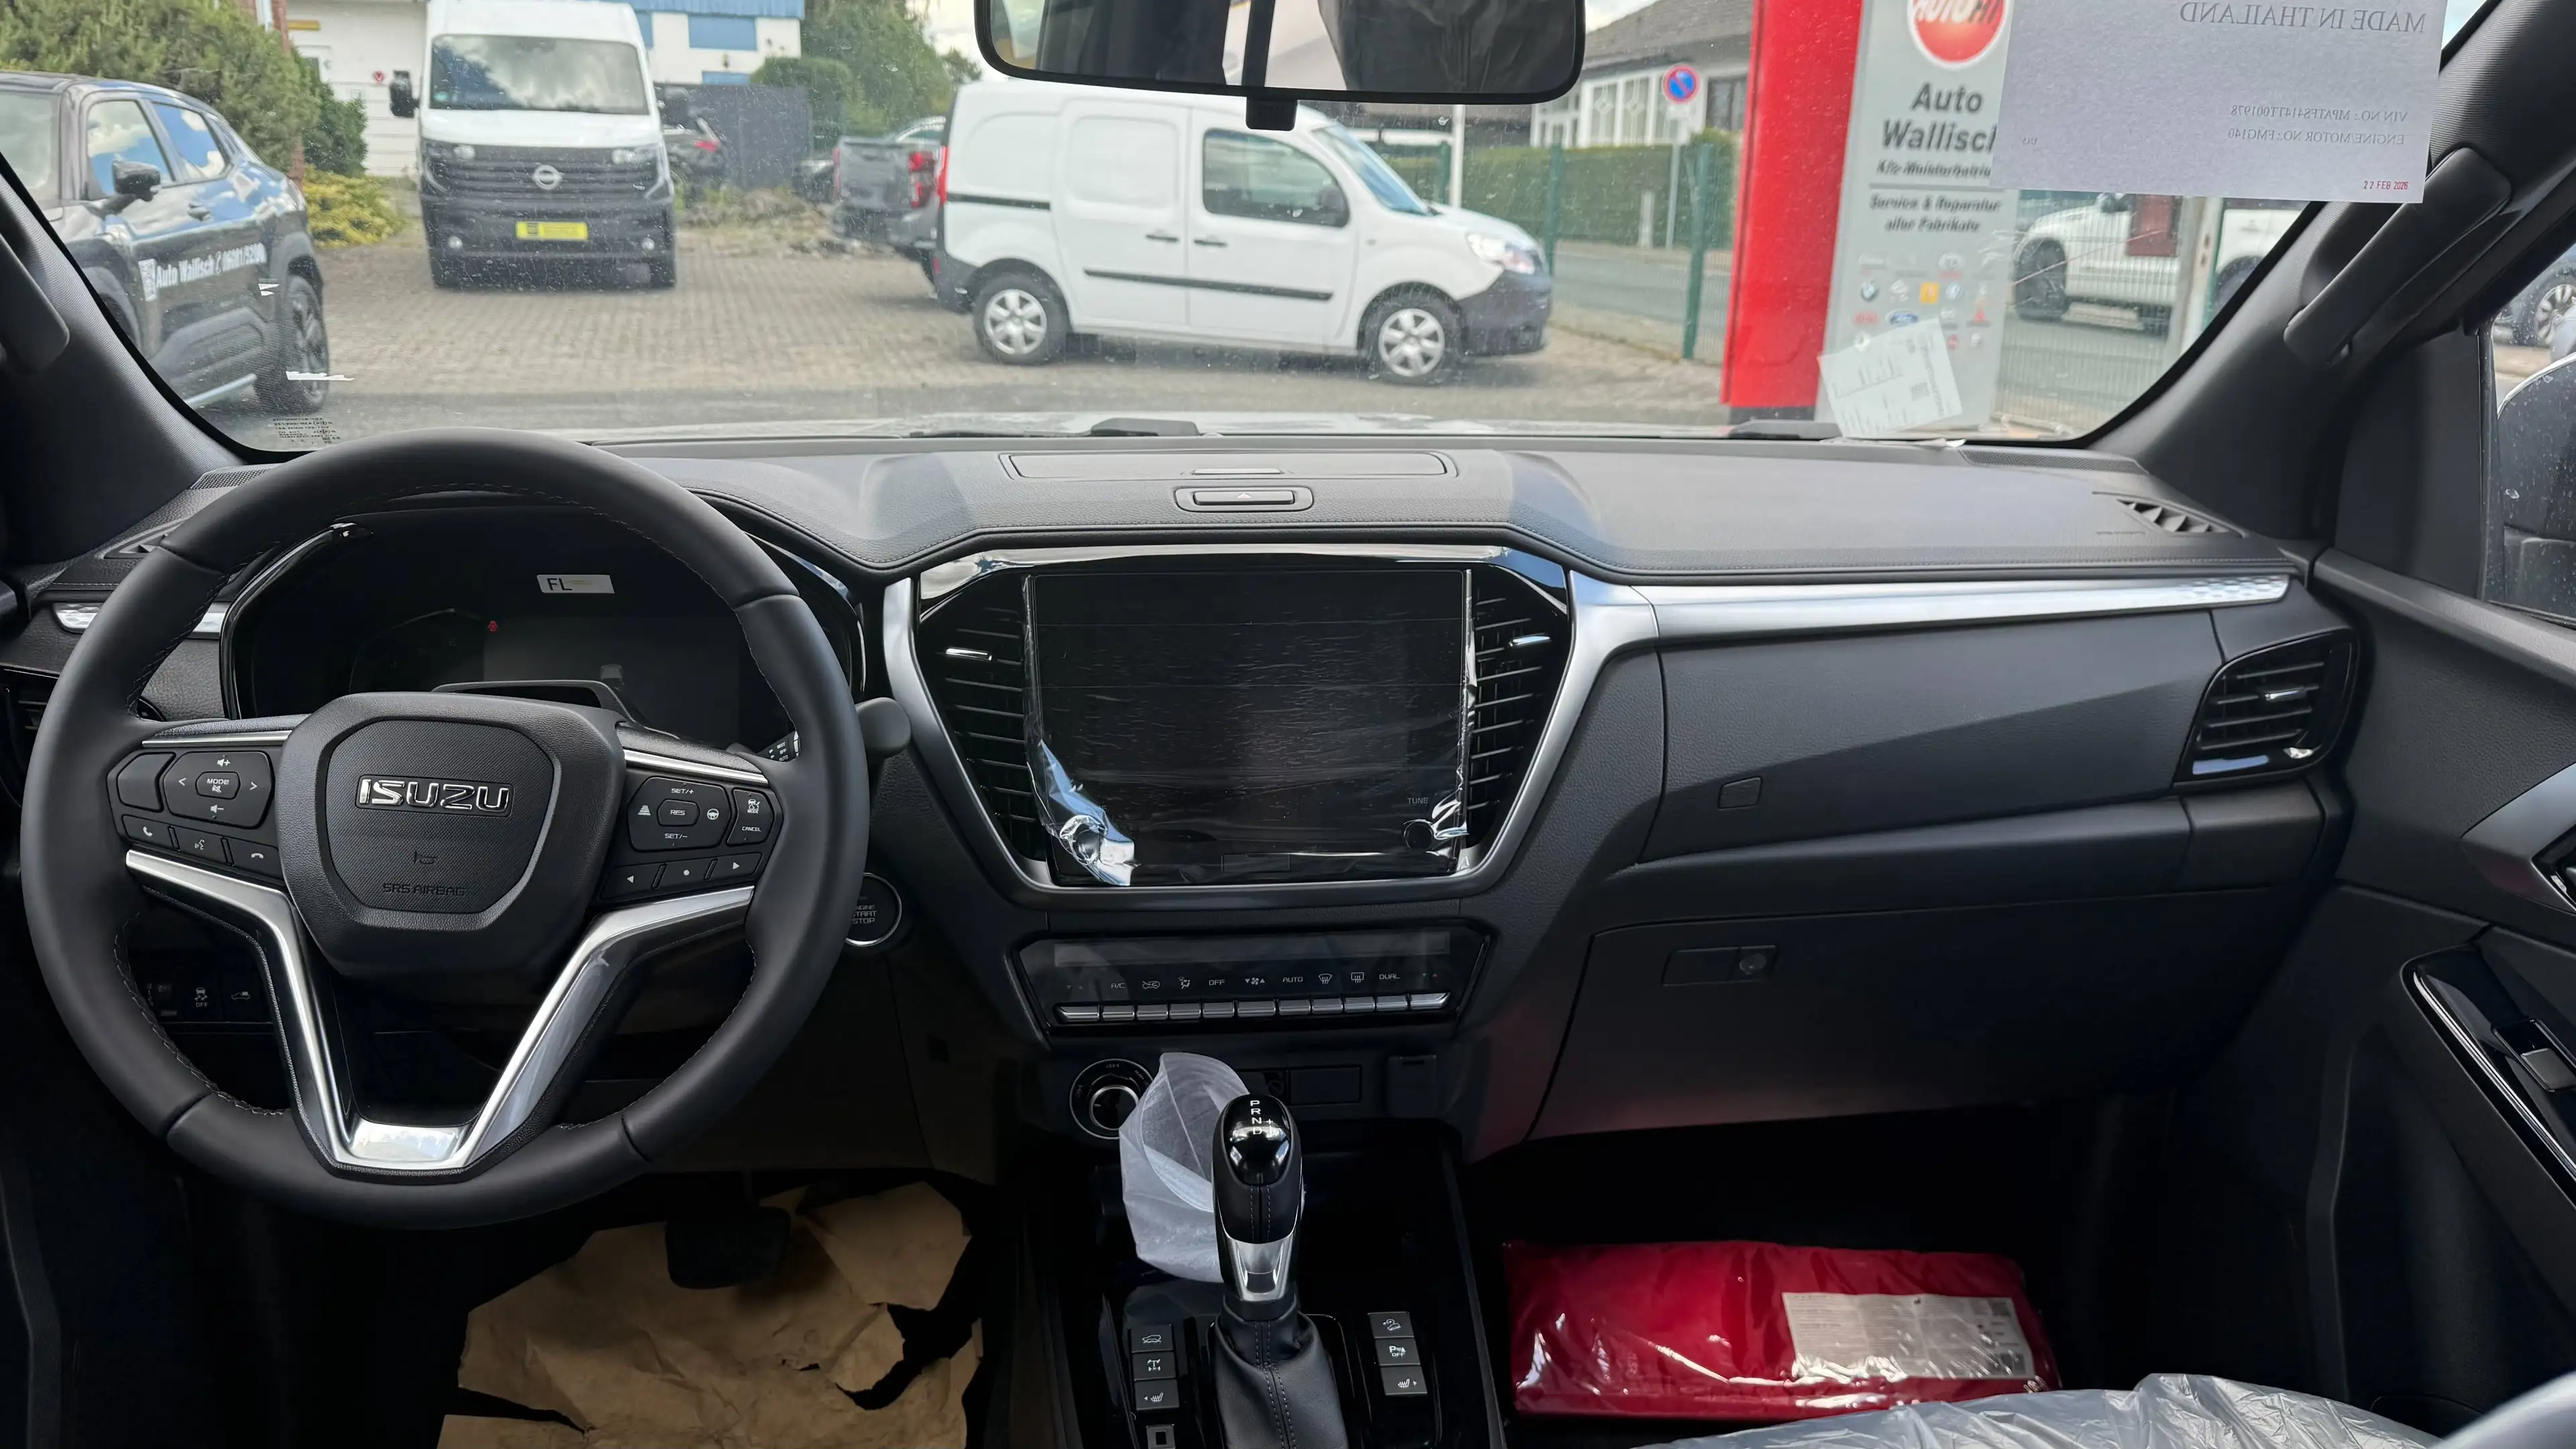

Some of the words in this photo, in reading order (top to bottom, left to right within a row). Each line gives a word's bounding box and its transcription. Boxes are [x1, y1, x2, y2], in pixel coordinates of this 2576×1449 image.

[1911, 83, 1983, 113] Auto
[2377, 180, 2391, 189] FEB
[2393, 181, 2408, 190] 2026
[1869, 193, 1918, 210] Service
[1935, 195, 2002, 213] Reparatur
[156, 264, 179, 289] Auto
[178, 254, 215, 283] Wallisch
[546, 578, 573, 591] FL
[359, 778, 510, 812] ISUZU
[382, 882, 411, 894] SRS
[413, 883, 467, 896] AIRBAG
[1252, 1126, 1263, 1135] D
